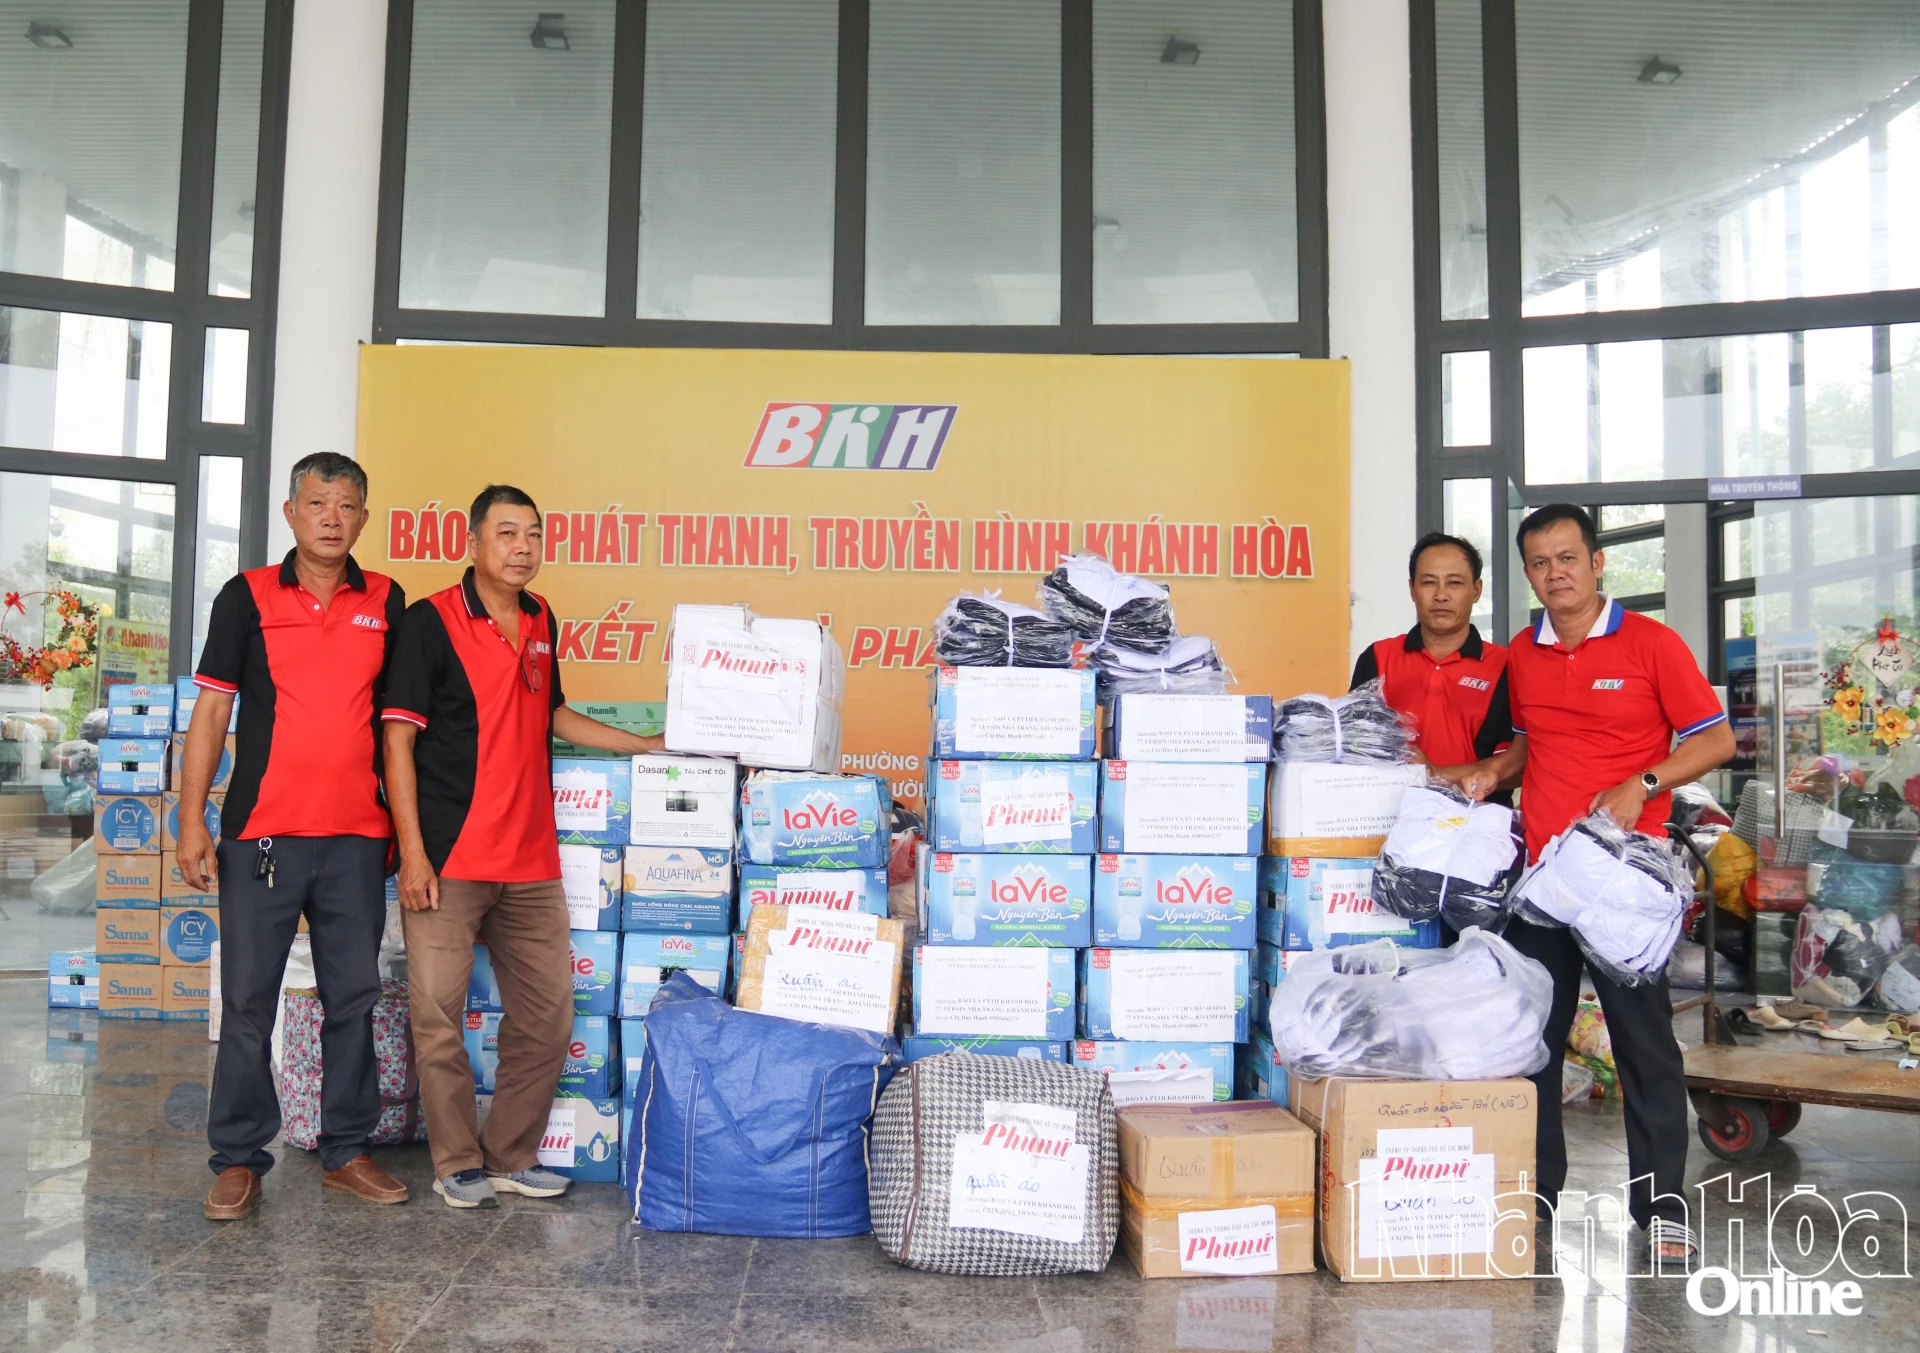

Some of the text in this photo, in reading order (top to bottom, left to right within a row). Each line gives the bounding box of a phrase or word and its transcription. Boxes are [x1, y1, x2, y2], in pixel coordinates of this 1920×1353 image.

[748, 403, 950, 468] BKH
[388, 500, 1315, 578] BÁO PHÁT THANH, TRUYỀN HÌNH KHÁNH HÒA
[353, 615, 381, 628] BKH
[558, 600, 657, 664] KẾT
[1458, 676, 1490, 692] BKH
[1593, 679, 1624, 690] KTV
[587, 706, 617, 715] Vinamilk
[842, 750, 919, 771] PHƯỜNG
[638, 765, 670, 774] Dasani
[115, 808, 142, 824] ICY
[784, 802, 857, 831] laVie
[105, 869, 150, 886] Sanna
[646, 866, 703, 883] AQUAFINA
[991, 876, 1068, 904] laVie
[1156, 877, 1233, 905] laVie
[104, 924, 149, 941] Sanna
[180, 921, 207, 936] ICY
[661, 938, 693, 951] laVie
[107, 979, 152, 996] Sanna
[173, 980, 209, 996] Sann
